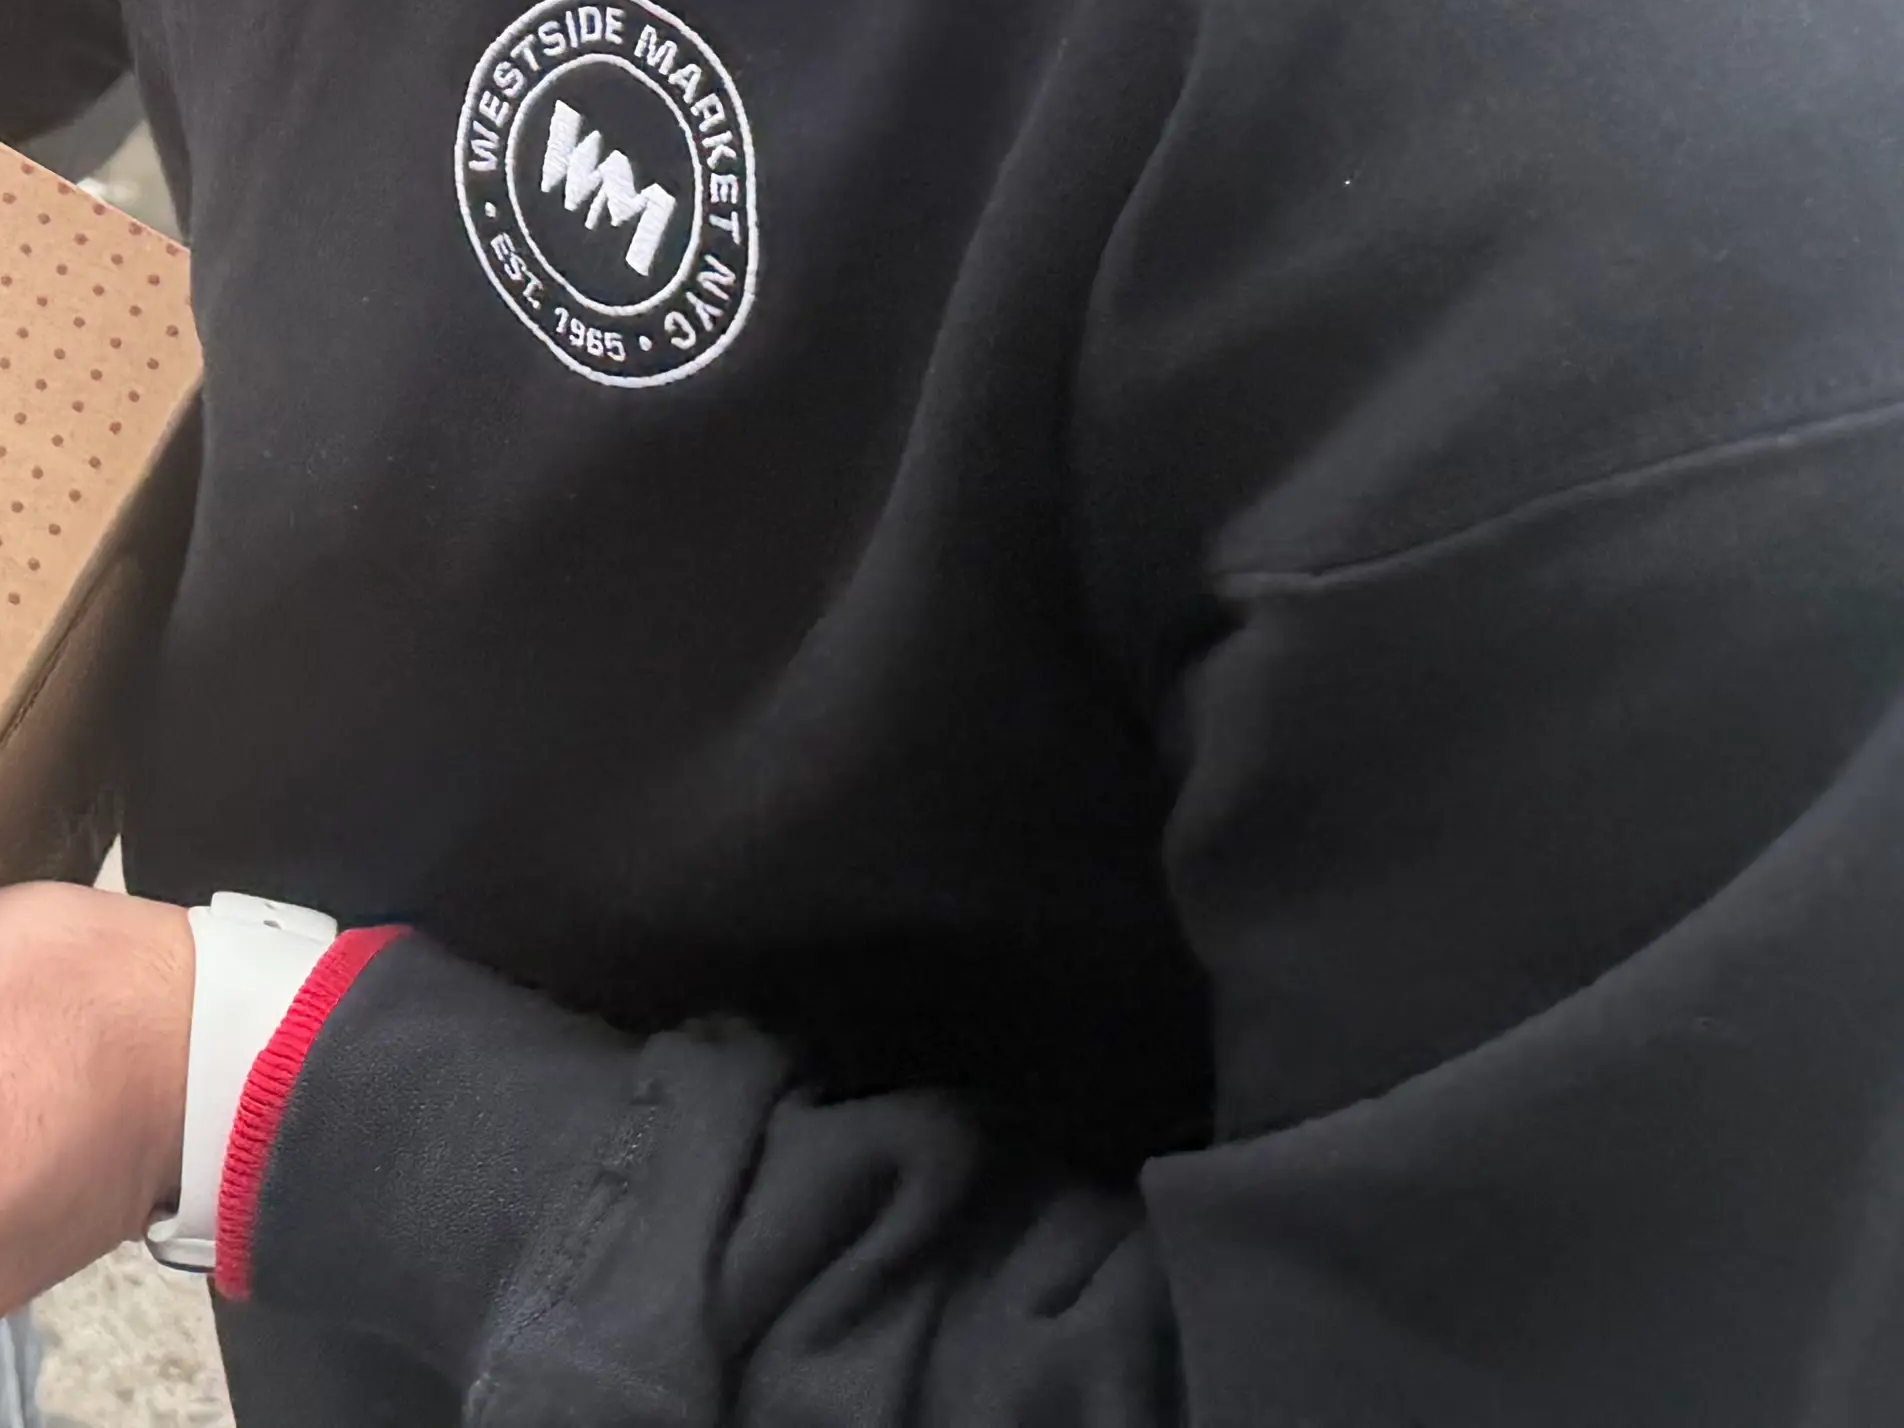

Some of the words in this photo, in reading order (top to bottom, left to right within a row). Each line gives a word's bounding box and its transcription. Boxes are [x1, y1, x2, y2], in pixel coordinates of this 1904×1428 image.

[469, 6, 626, 171] WESTSIDE
[634, 25, 741, 244] MARKET
[541, 99, 676, 276] WM
[491, 233, 542, 310] EST.
[555, 307, 626, 362] 1965
[665, 255, 737, 350] NYC
